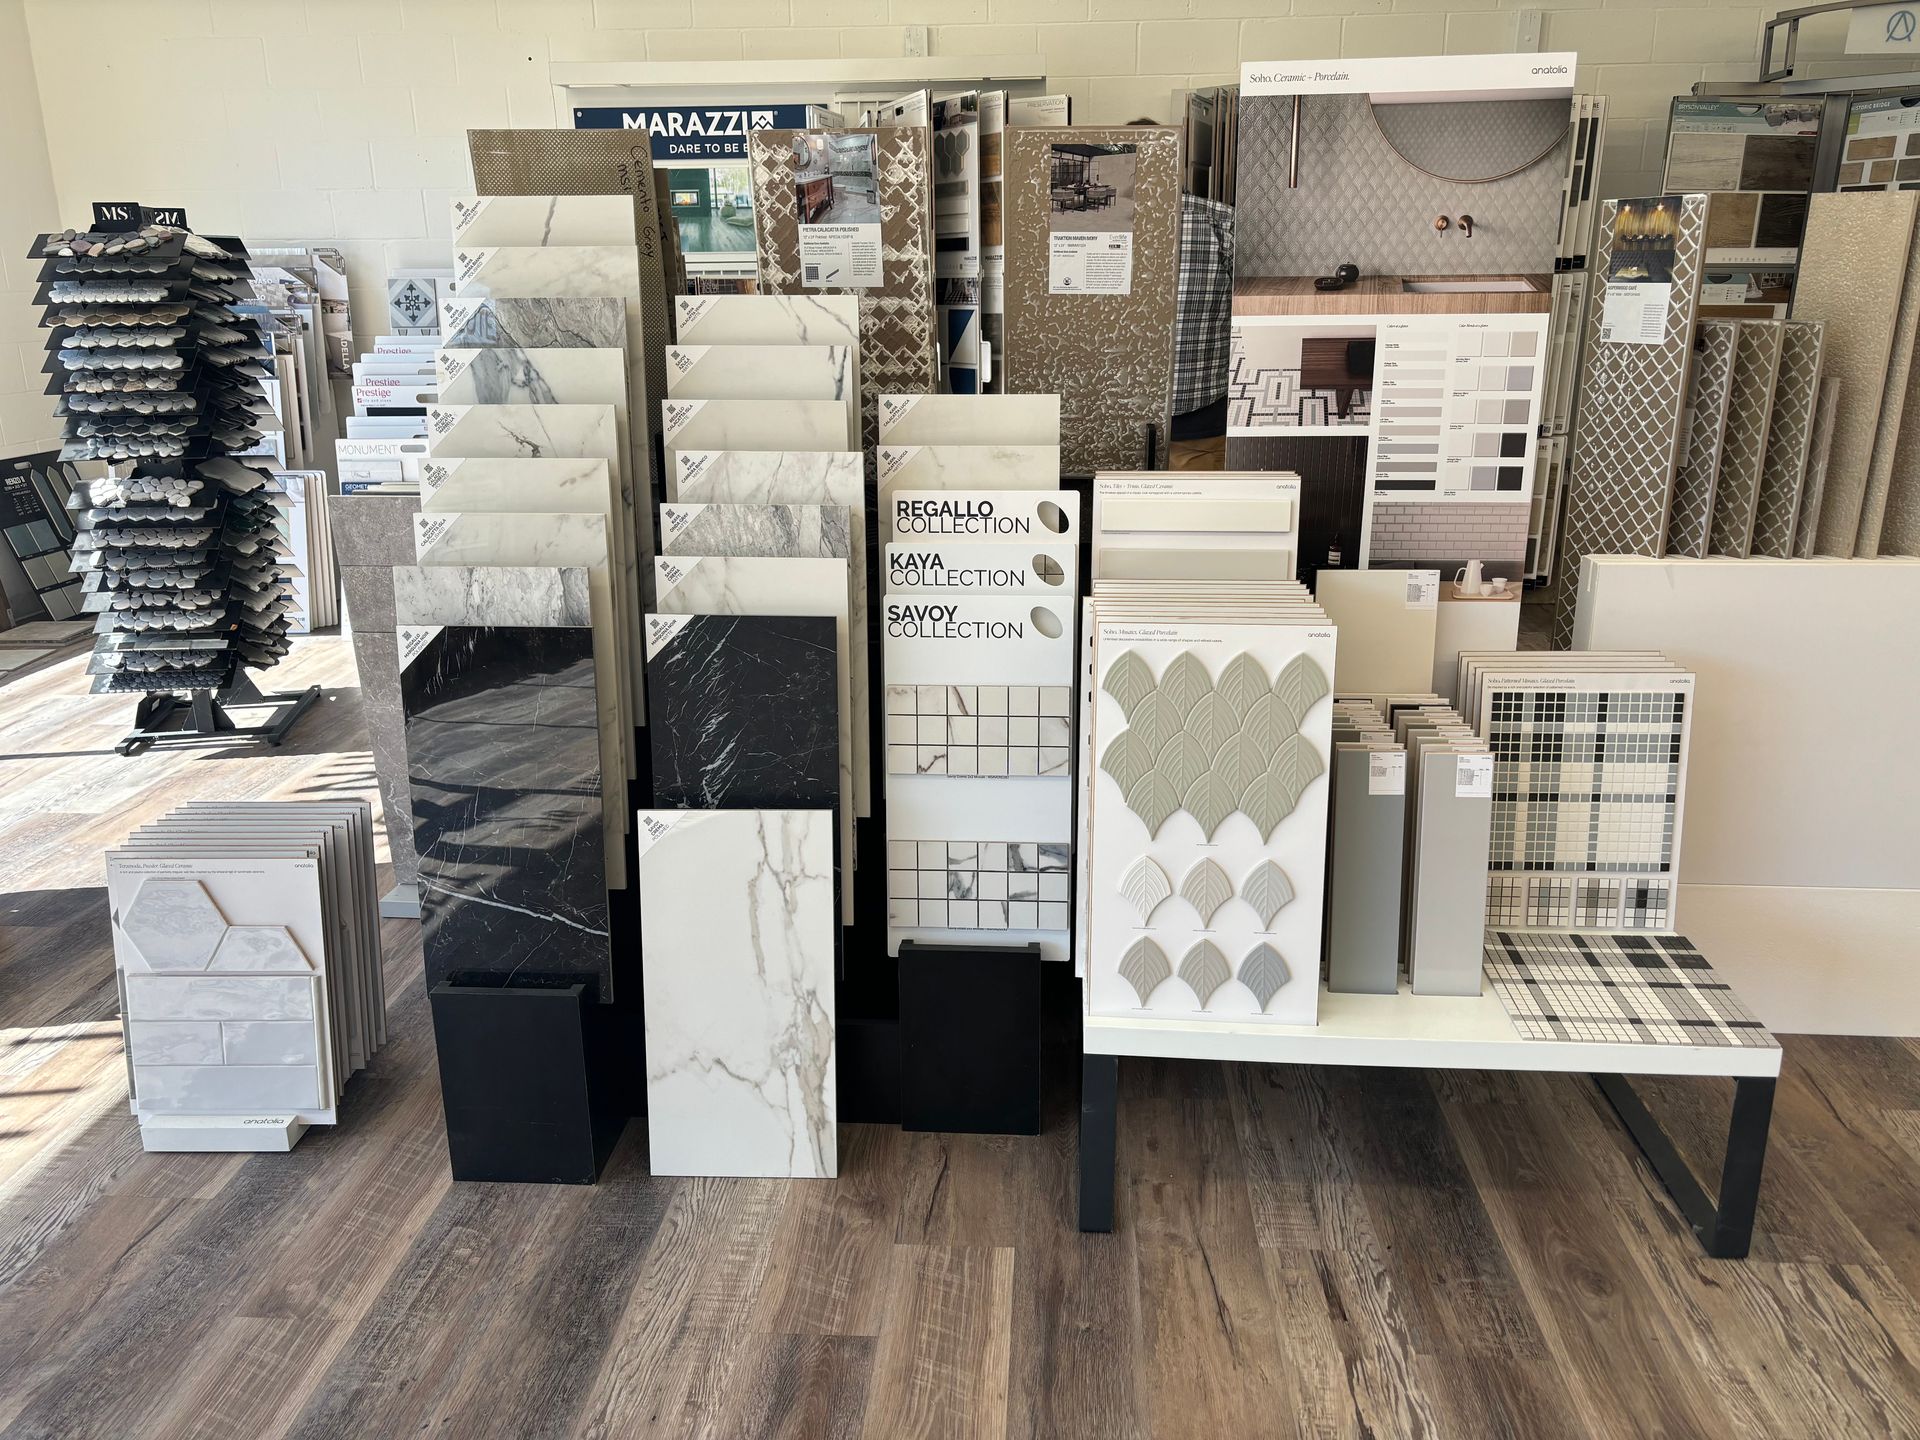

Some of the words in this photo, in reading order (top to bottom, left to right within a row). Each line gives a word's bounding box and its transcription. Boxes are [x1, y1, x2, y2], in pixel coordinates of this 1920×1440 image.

[1274, 73, 1306, 82] Ceramic
[1314, 72, 1350, 81] Porcelain.
[1532, 66, 1568, 74] anatolia
[622, 112, 748, 137] MARAZZI
[669, 144, 701, 154] DARE
[705, 143, 719, 153] TO
[724, 143, 740, 153] BE
[356, 388, 391, 398] Prestige
[338, 444, 398, 455] MONUMENT
[897, 500, 994, 517] REGALLO
[896, 517, 1030, 534] COLLECTION
[890, 553, 944, 569] KAYA
[890, 570, 1024, 586] COLLECTION
[888, 605, 958, 622] SAVOY
[888, 622, 1023, 639] COLLECTION
